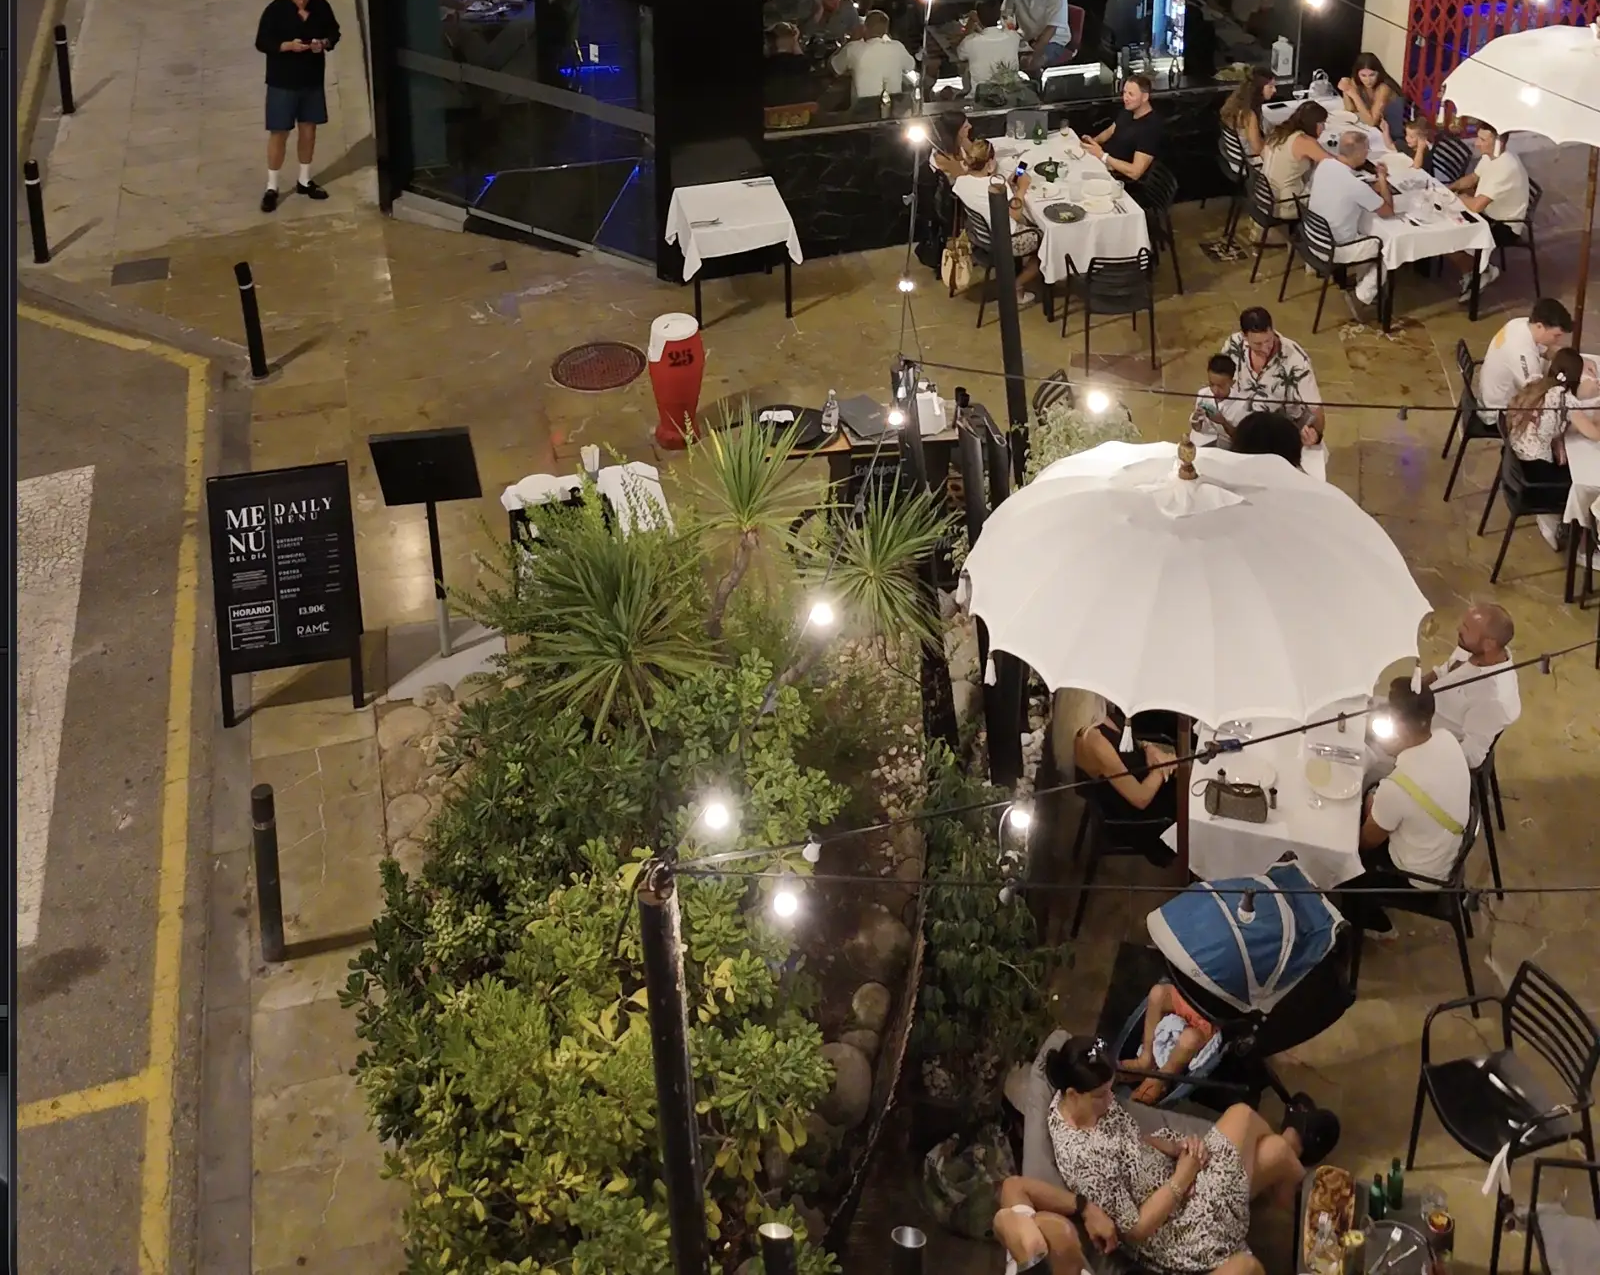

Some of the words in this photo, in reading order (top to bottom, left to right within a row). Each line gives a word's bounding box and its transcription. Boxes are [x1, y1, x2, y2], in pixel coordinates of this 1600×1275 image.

[667, 348, 694, 368] 25
[273, 496, 332, 517] DAILY
[225, 505, 266, 530] ME
[274, 512, 318, 525] MENU
[228, 526, 266, 555] NÚ
[229, 555, 246, 563] DEL
[251, 552, 267, 561] DÍA
[232, 605, 271, 618] HORARIO
